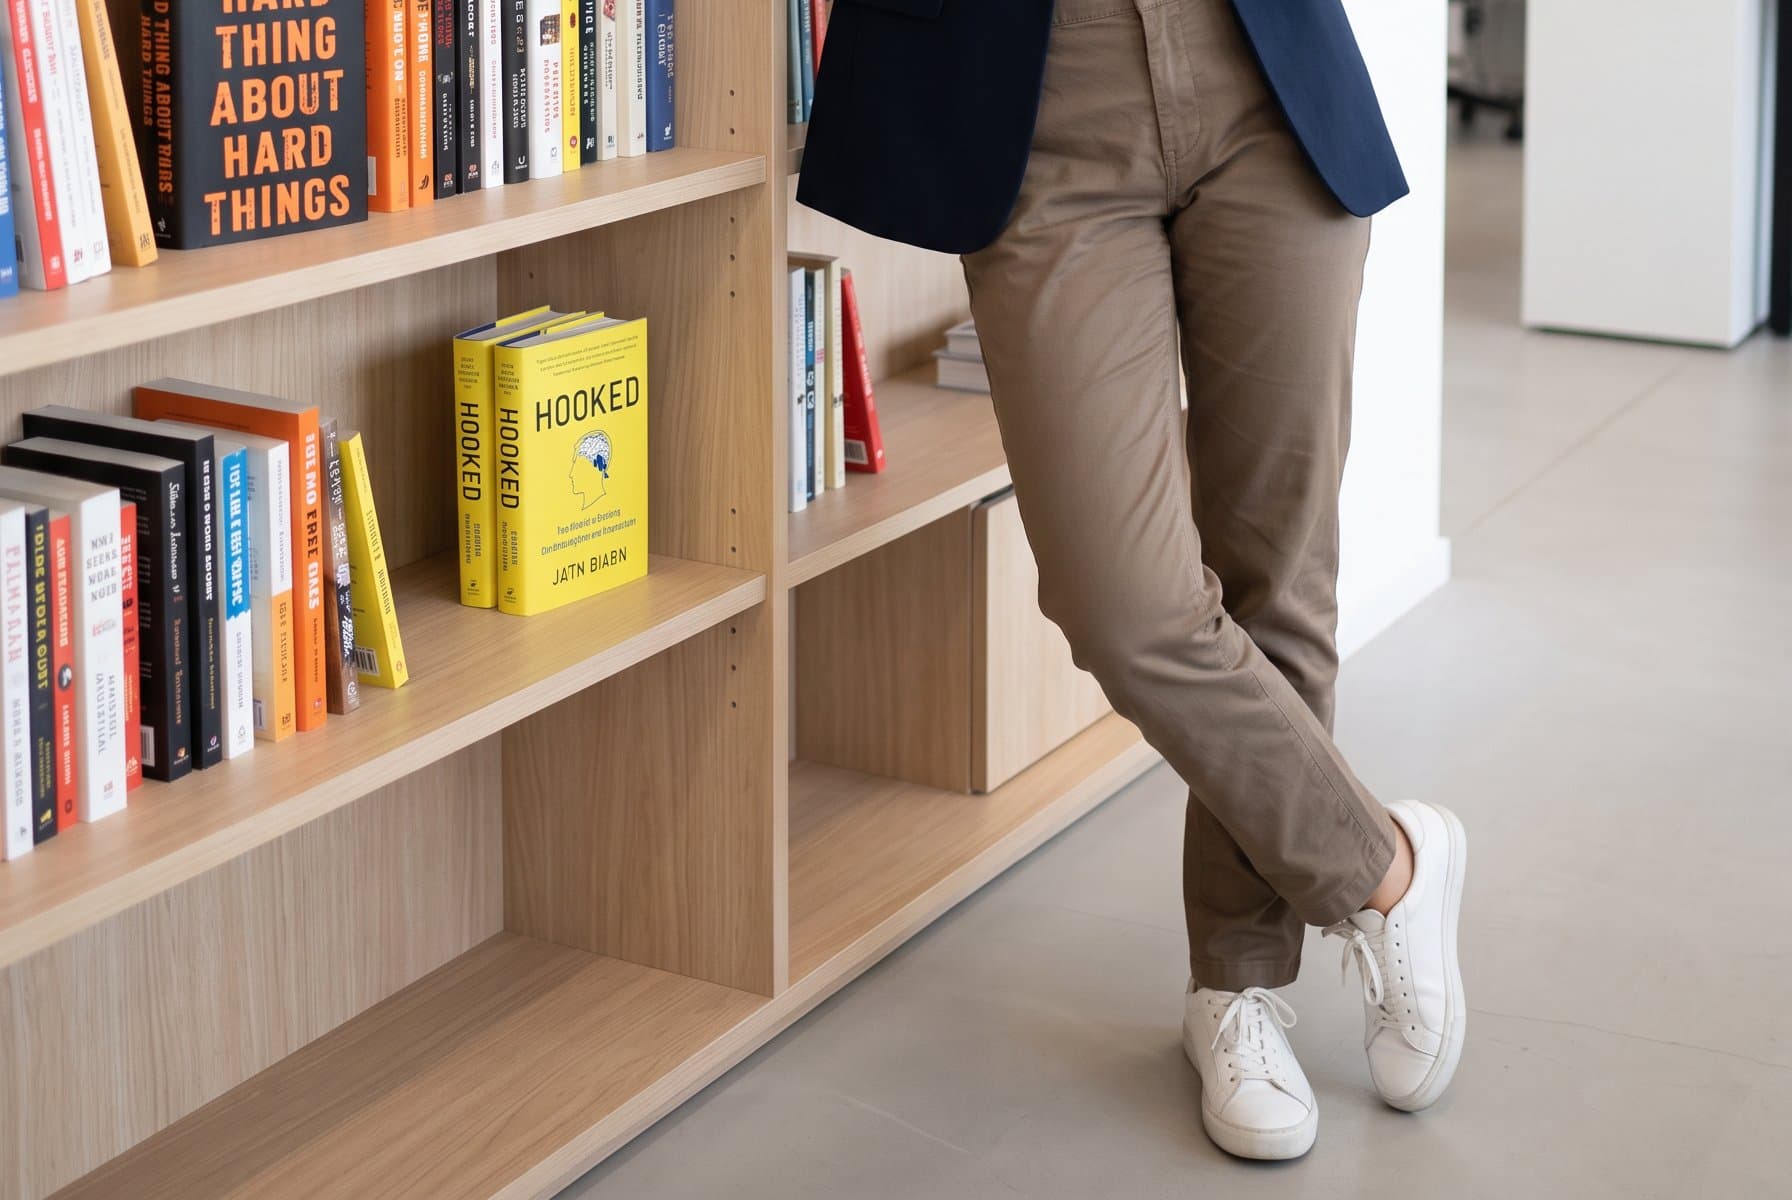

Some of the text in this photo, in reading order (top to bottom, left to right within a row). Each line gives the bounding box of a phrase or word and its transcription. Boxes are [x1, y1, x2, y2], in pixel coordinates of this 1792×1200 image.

[140, 15, 153, 128] HARD THINGS
[154, 17, 170, 74] THING
[215, 17, 336, 69] THING
[155, 75, 171, 136] ABOUT
[210, 69, 344, 126] ABOUT
[223, 124, 332, 179] HARD
[204, 174, 350, 236] THINGS
[535, 375, 640, 432] HOOKED
[460, 402, 481, 501] HOOKED
[499, 407, 520, 510] HOOKED
[553, 561, 585, 585] JATN
